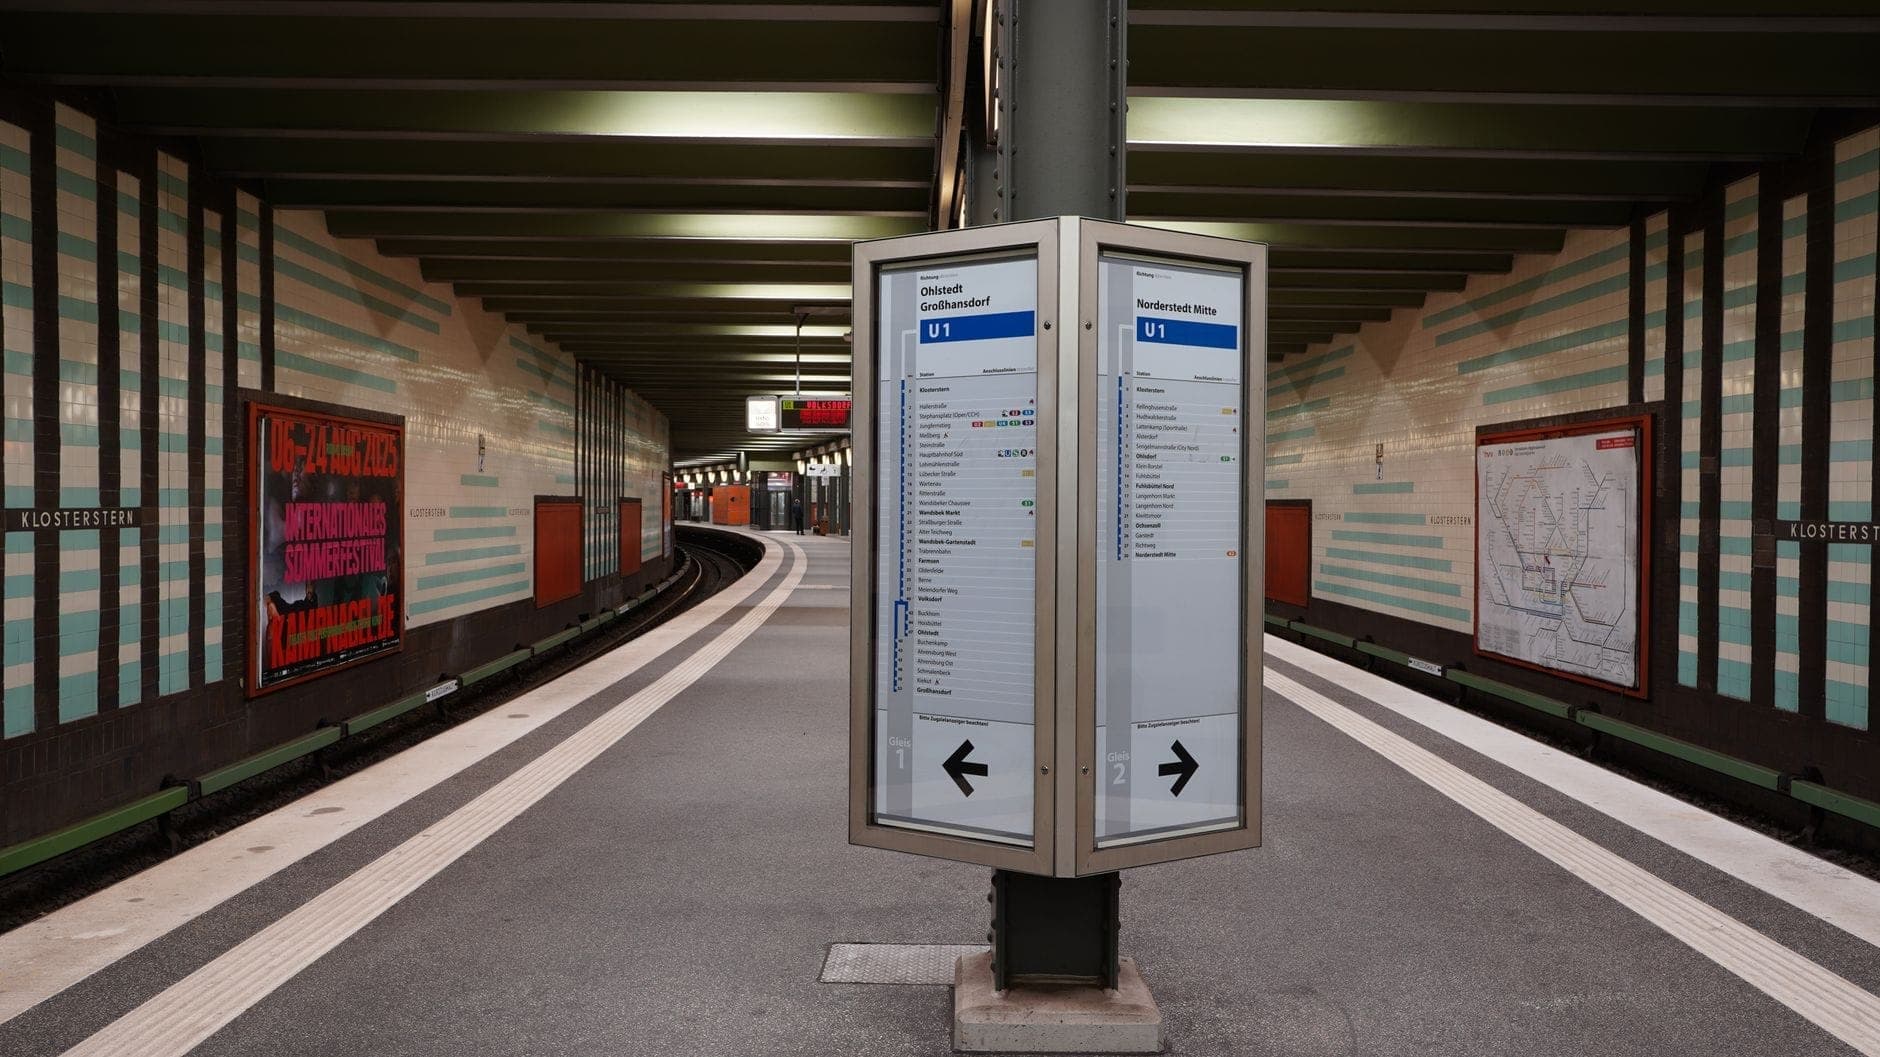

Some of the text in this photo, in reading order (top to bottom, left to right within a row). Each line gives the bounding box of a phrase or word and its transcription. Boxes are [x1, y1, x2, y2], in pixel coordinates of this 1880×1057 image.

[921, 283, 963, 296] Ohlstedt
[920, 296, 990, 312] Großhansdorf
[1137, 299, 1217, 316] Norderstedt Mitte
[363, 430, 397, 477] 2025
[22, 510, 133, 528] KLOSTERSTERN
[285, 502, 386, 540] INTERNATIONALES
[1430, 515, 1472, 526] KLOSTERSTERN
[284, 538, 386, 584] SOMMERFESTIVAL
[889, 737, 911, 747] Gleis
[896, 749, 903, 769] 1
[1108, 751, 1130, 762] Gleis
[1113, 762, 1126, 785] 2
